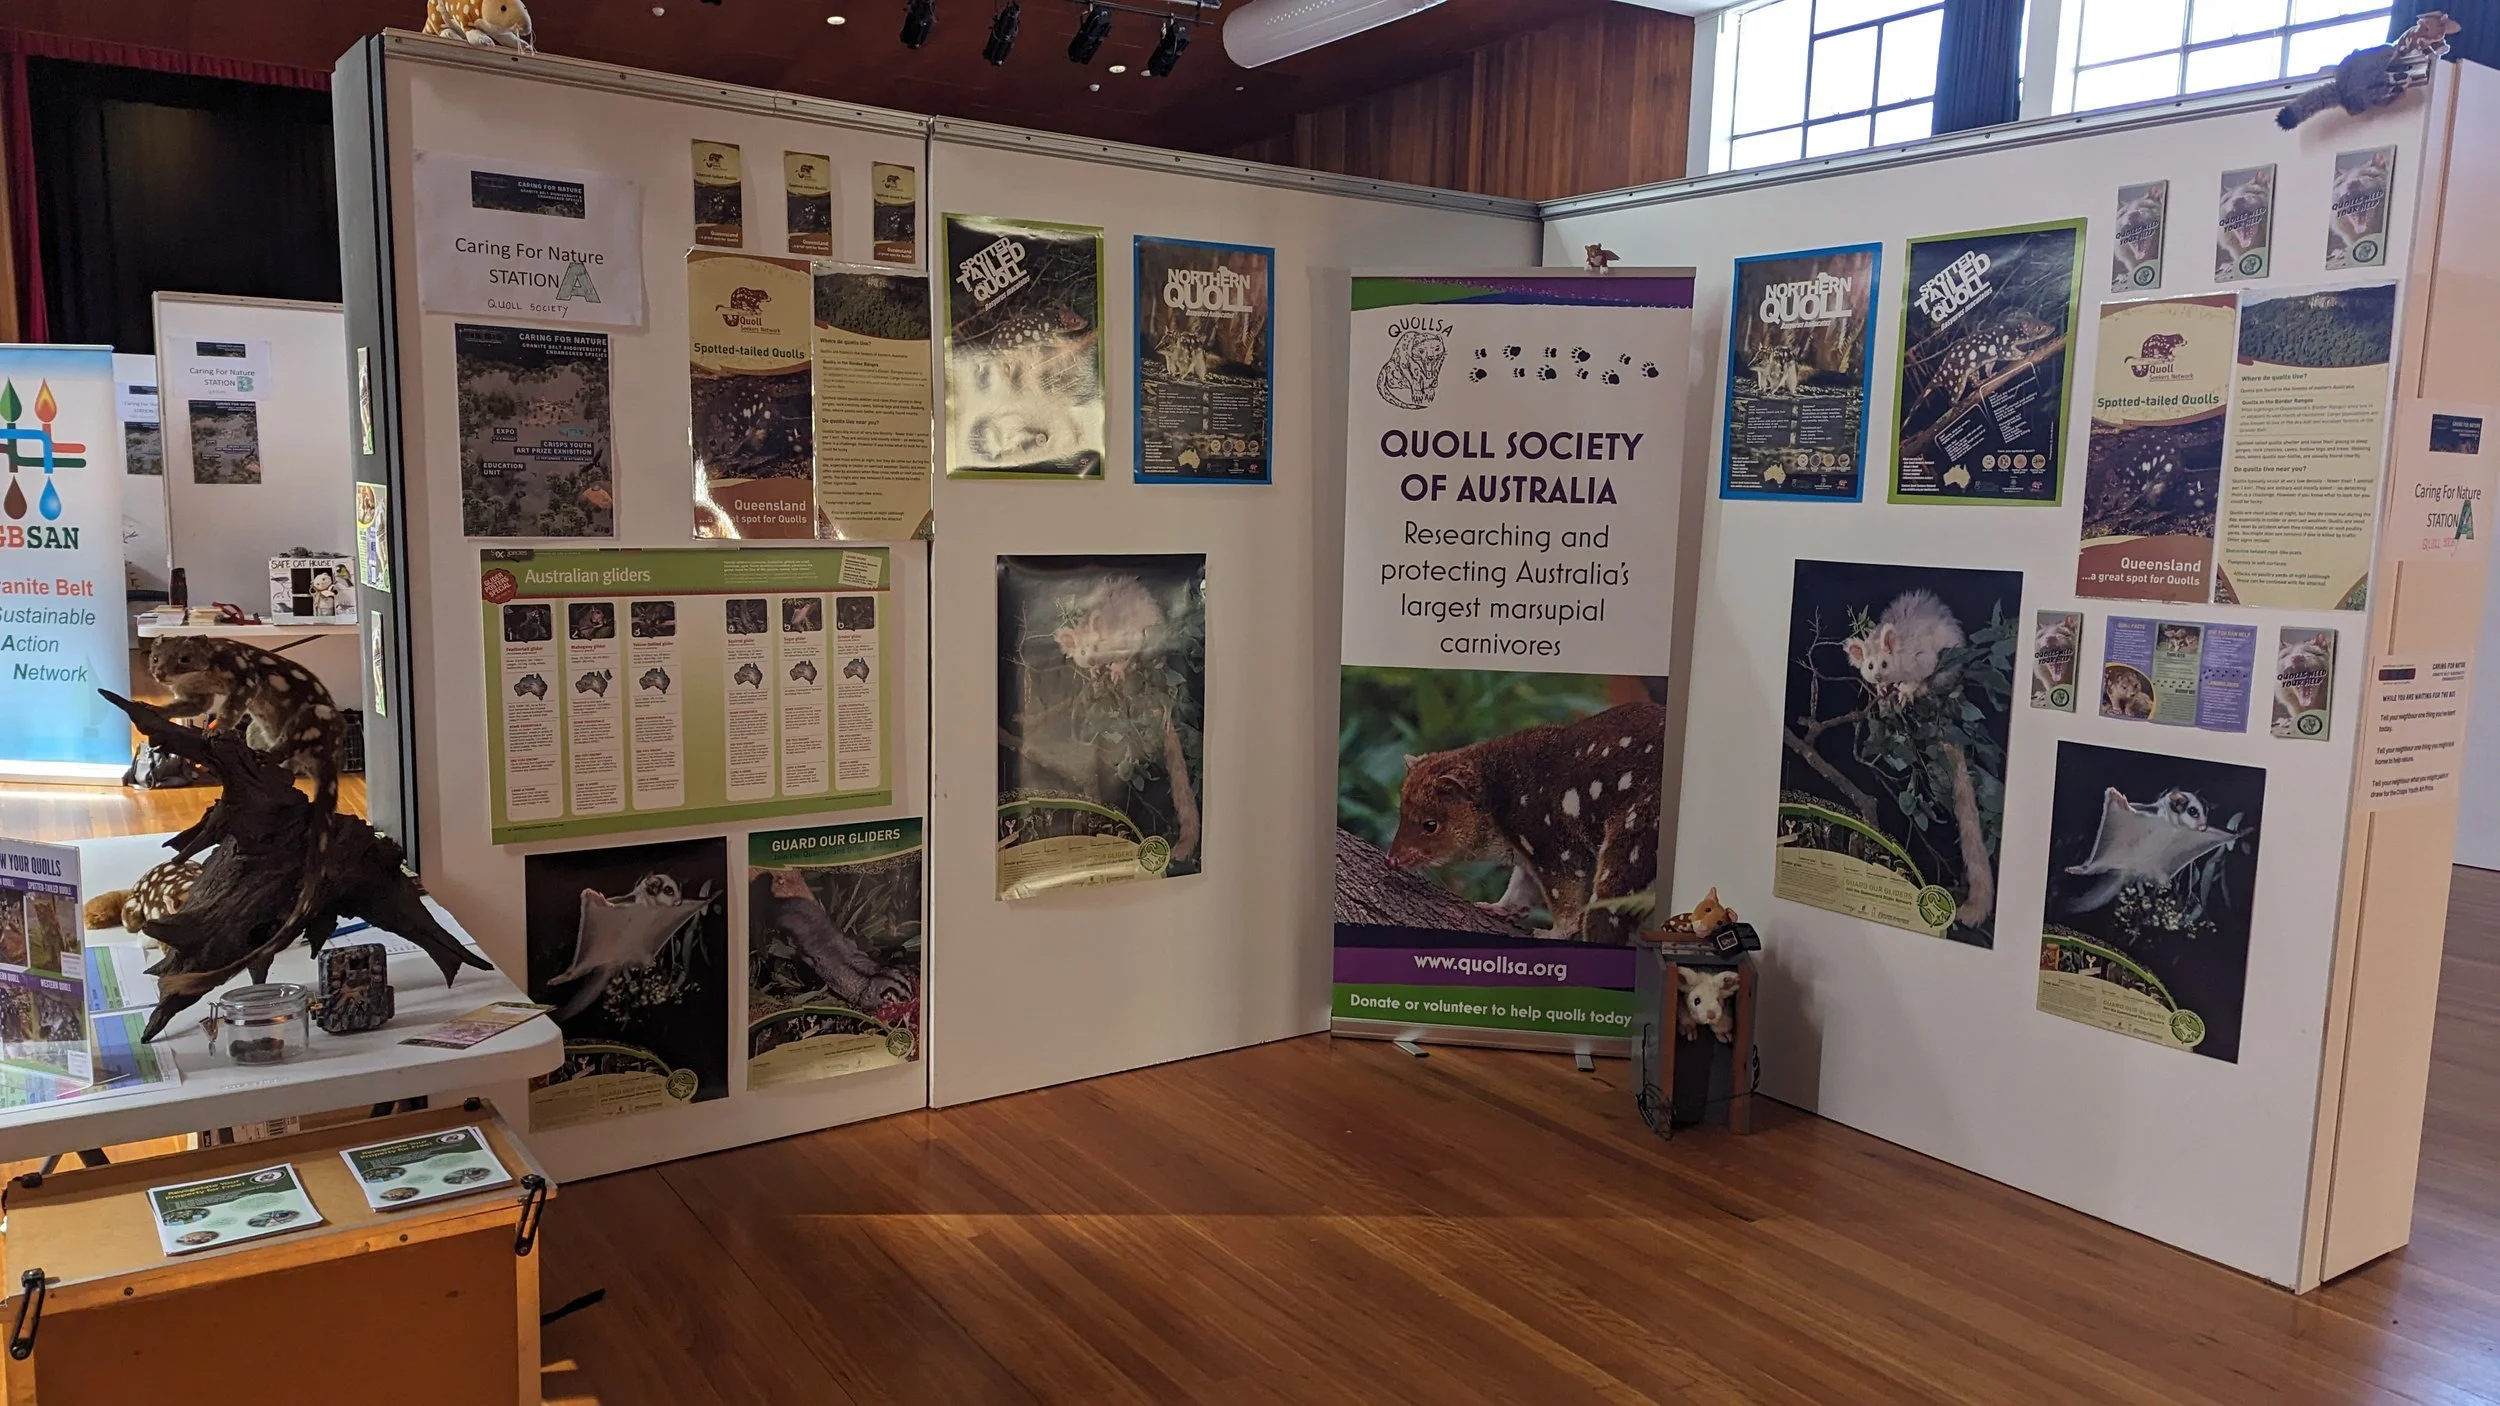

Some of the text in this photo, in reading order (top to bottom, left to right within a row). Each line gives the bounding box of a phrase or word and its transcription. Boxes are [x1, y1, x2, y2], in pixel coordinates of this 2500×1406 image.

[518, 181, 542, 190] CARING
[557, 186, 582, 194] NATURE
[455, 237, 604, 265] Caring For Nature
[959, 237, 1011, 273] SPOTTED
[955, 242, 1026, 293] TAILED
[1919, 250, 1975, 296] SPOTTED
[489, 262, 601, 303] STATION A
[974, 262, 1028, 301] QUOLL
[1167, 268, 1251, 290] NORTHERN
[1765, 276, 1852, 299] NORTHERN
[1913, 253, 1991, 315] TAILED
[1163, 281, 1253, 313] QUOLL
[1931, 274, 1991, 322] QUOLL
[487, 299, 569, 318] QUOLL SOCIETY
[1760, 290, 1852, 325] QUOLL
[740, 316, 762, 326] Quoll
[1388, 316, 1454, 338] QUOLLSA
[519, 333, 608, 346] CARING FOR NATURE
[563, 345, 602, 353] BIODIVERSITY
[694, 343, 769, 357] Spotted-tailed
[771, 347, 805, 359] Quolls
[189, 367, 214, 376] Caring
[229, 368, 255, 377] Nature
[2149, 364, 2174, 374] Quoll
[2241, 374, 2262, 382] Where
[2271, 373, 2291, 382] quolls
[204, 378, 236, 387] STATION
[2097, 393, 2220, 410] Spotted-tailed Quolls
[1380, 429, 1644, 461] QUOLL SOCIETY
[2291, 465, 2307, 473] you?
[1400, 473, 1617, 504] OF AUSTRALIA
[2414, 483, 2482, 502] Caring For Nature
[734, 499, 806, 512] Queensland
[741, 515, 761, 524] spot
[763, 514, 777, 523] for
[778, 515, 807, 524] Quolls
[2427, 499, 2474, 540] STATION A
[1404, 520, 1609, 553] Researching and
[271, 560, 291, 569] SAFE
[293, 560, 306, 568] CAT
[2121, 557, 2202, 572] Queensland
[525, 567, 651, 585] Australian gliders
[1381, 560, 1630, 589] protecting Australia's
[2098, 573, 2124, 583] great
[2126, 574, 2147, 584] spot
[2150, 574, 2165, 584] for
[2166, 575, 2200, 586] Quolls
[0, 578, 94, 597] anite Belt
[1401, 593, 1605, 626] largest marsupial
[1, 634, 59, 653] Action
[1440, 633, 1561, 656] carnivores
[13, 663, 89, 683] Network
[2382, 694, 2397, 702] WHILE
[2406, 693, 2414, 701] ARE
[2415, 692, 2432, 700] WAITING
[2389, 714, 2398, 722] your
[2385, 747, 2395, 755] your
[2381, 780, 2391, 788] your
[772, 828, 901, 852] GUARD OUR GLIDERS
[8, 854, 29, 873] YOUR
[31, 857, 61, 877] QUOLLS
[1845, 879, 1913, 900] GUARD OUR GLIDERS
[1414, 954, 1568, 982] www.quollsa.org
[40, 979, 58, 989] WESTERN
[1350, 993, 1632, 1028] Donate or volunteer to help quolls today
[165, 1188, 205, 1200] Property
[168, 1183, 218, 1196] Revegetate
